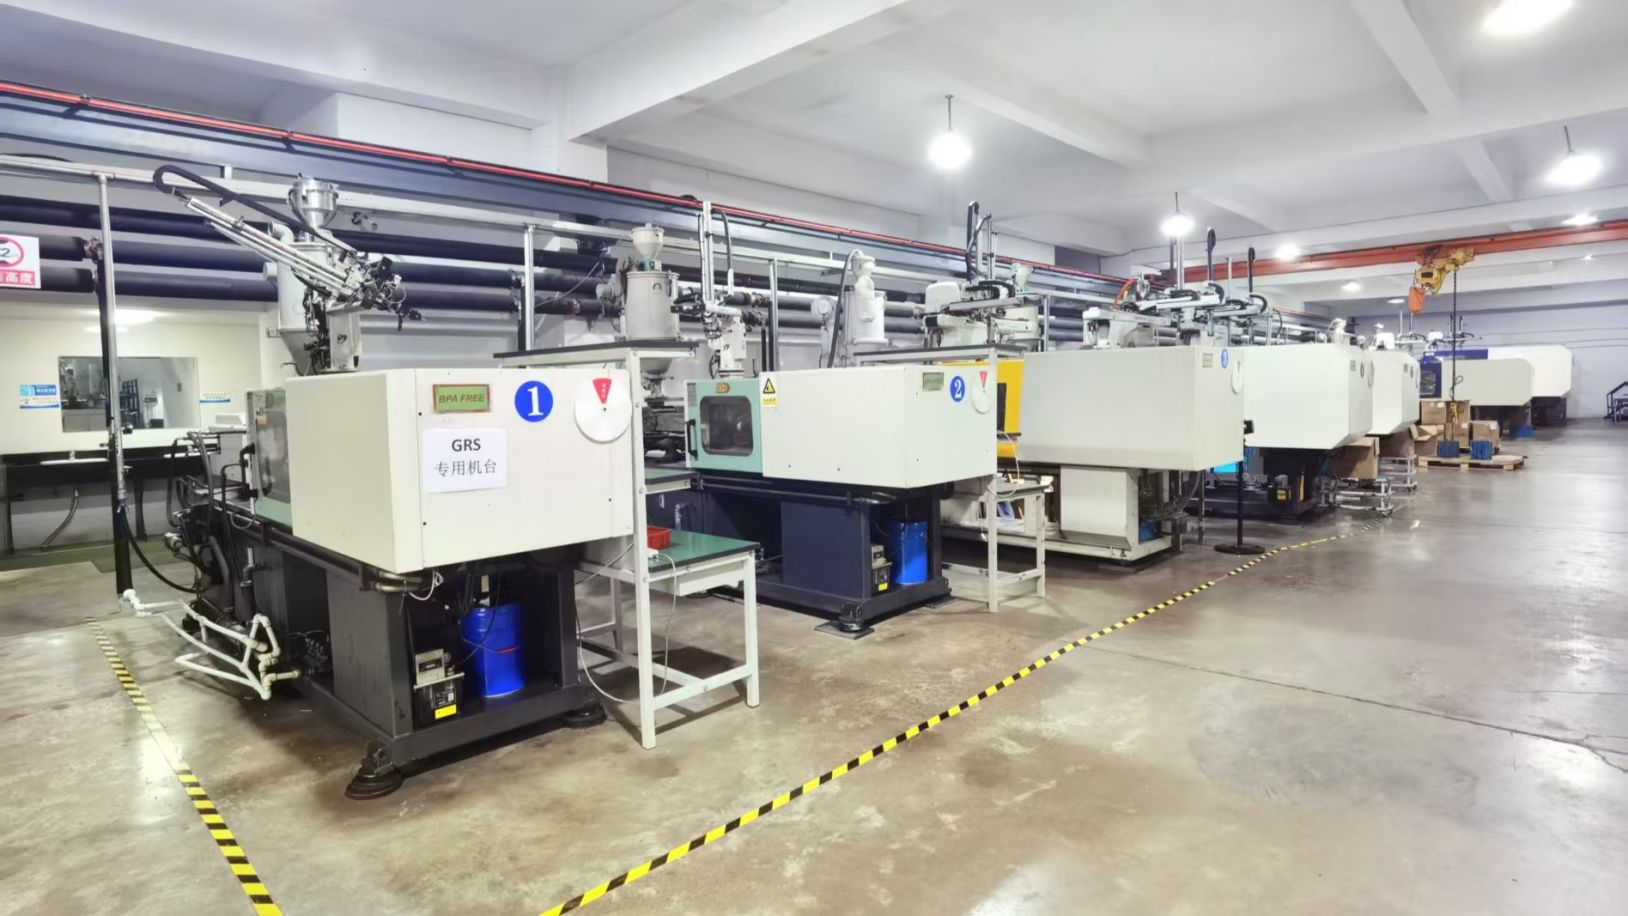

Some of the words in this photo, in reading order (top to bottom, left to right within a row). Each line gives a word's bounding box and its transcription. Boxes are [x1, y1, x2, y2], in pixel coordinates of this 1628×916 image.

[439, 394, 458, 403] BPA
[459, 393, 485, 402] FREE
[954, 379, 962, 399] 2
[527, 386, 543, 416] 1
[451, 438, 481, 452] GRS
[434, 459, 497, 477] 专用机台
